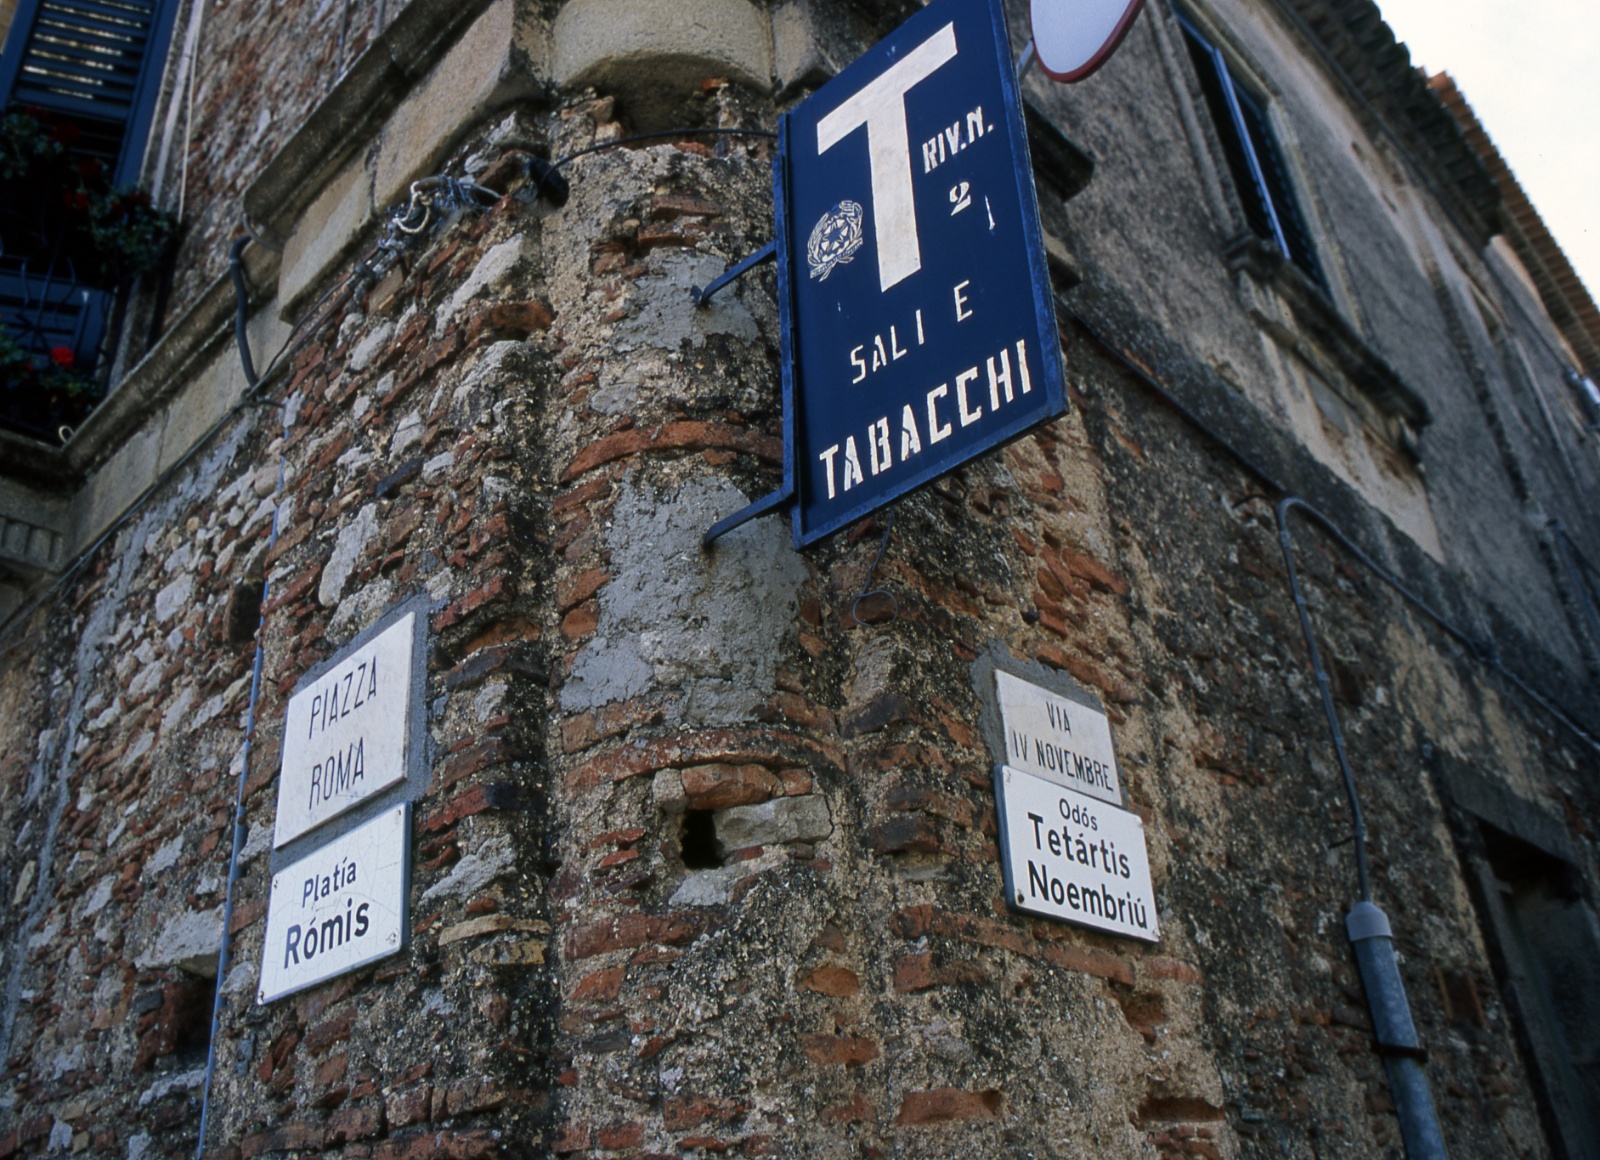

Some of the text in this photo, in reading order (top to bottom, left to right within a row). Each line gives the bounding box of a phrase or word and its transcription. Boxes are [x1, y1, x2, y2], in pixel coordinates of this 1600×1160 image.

[817, 21, 958, 292] T
[949, 181, 971, 216] 2
[850, 280, 973, 384] SALI E
[819, 339, 1031, 500] TABACCHI
[309, 656, 377, 740] PIAZZA
[1046, 702, 1071, 736] VIA
[309, 737, 364, 811] ROMA
[1013, 731, 1113, 792] IV NOVEMBRE
[1028, 812, 1131, 879] Tetártis
[1059, 798, 1098, 831] Odós
[302, 856, 357, 908] Platía
[1028, 860, 1148, 930] Noembriú
[284, 898, 370, 969] Rómis
